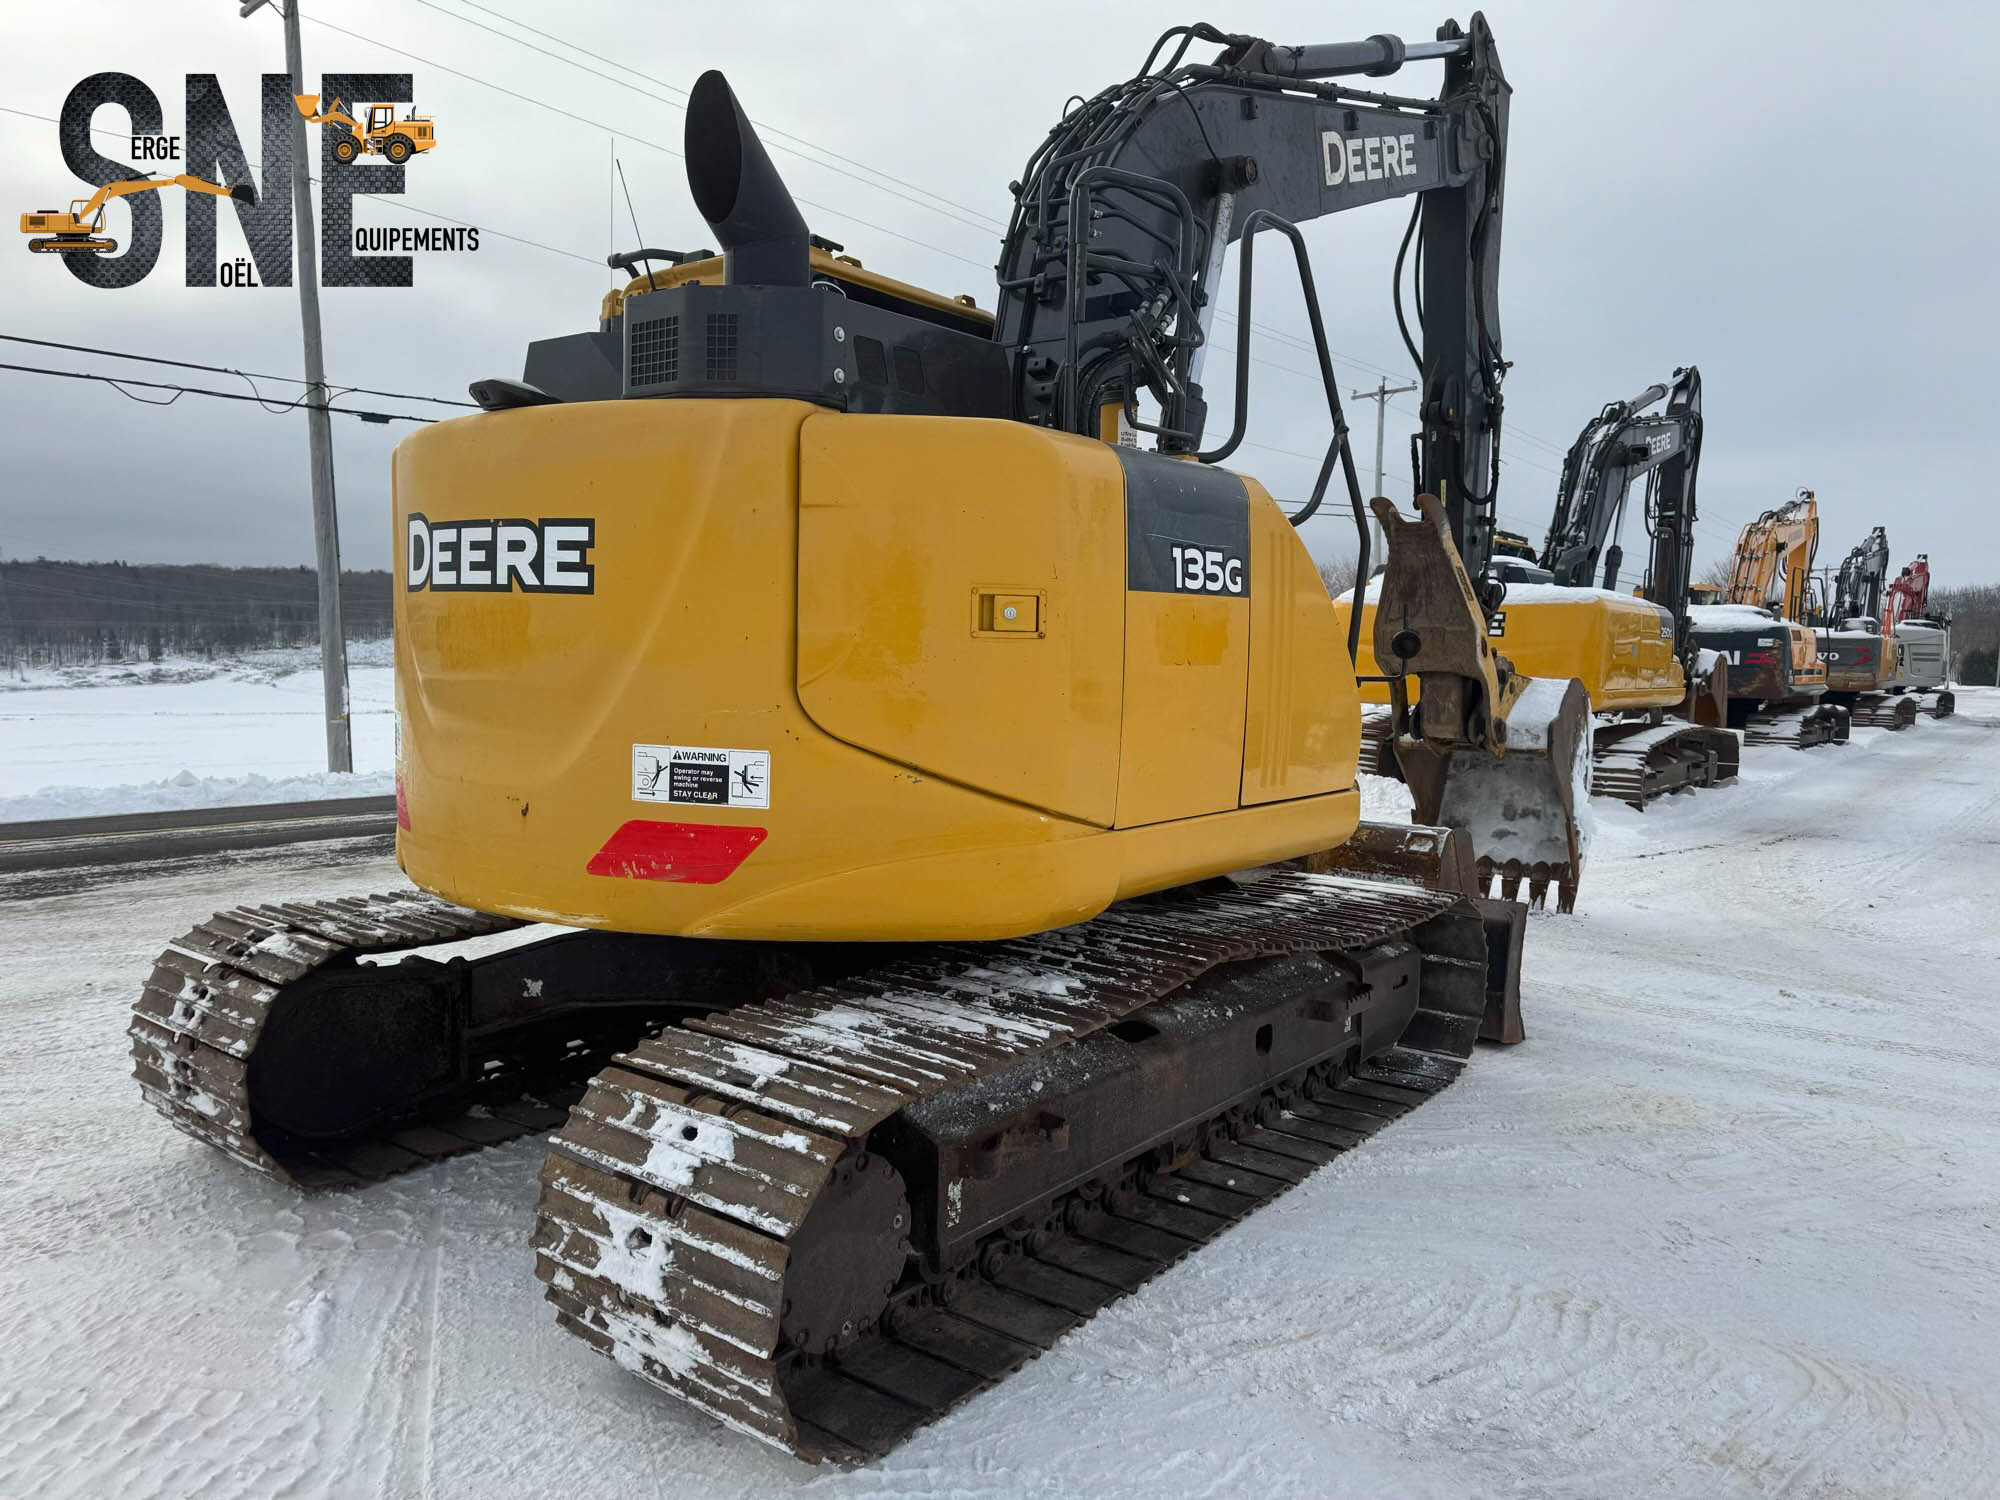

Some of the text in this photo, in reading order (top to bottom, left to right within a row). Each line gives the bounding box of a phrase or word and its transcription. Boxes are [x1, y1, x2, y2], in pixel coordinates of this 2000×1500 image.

[1321, 131, 1417, 186] DEERE
[408, 517, 592, 590] DEERE
[1172, 546, 1242, 593] 135G
[673, 767, 700, 776] Operator
[682, 751, 727, 763] WARNING
[673, 790, 718, 799] STAY CLEAR
